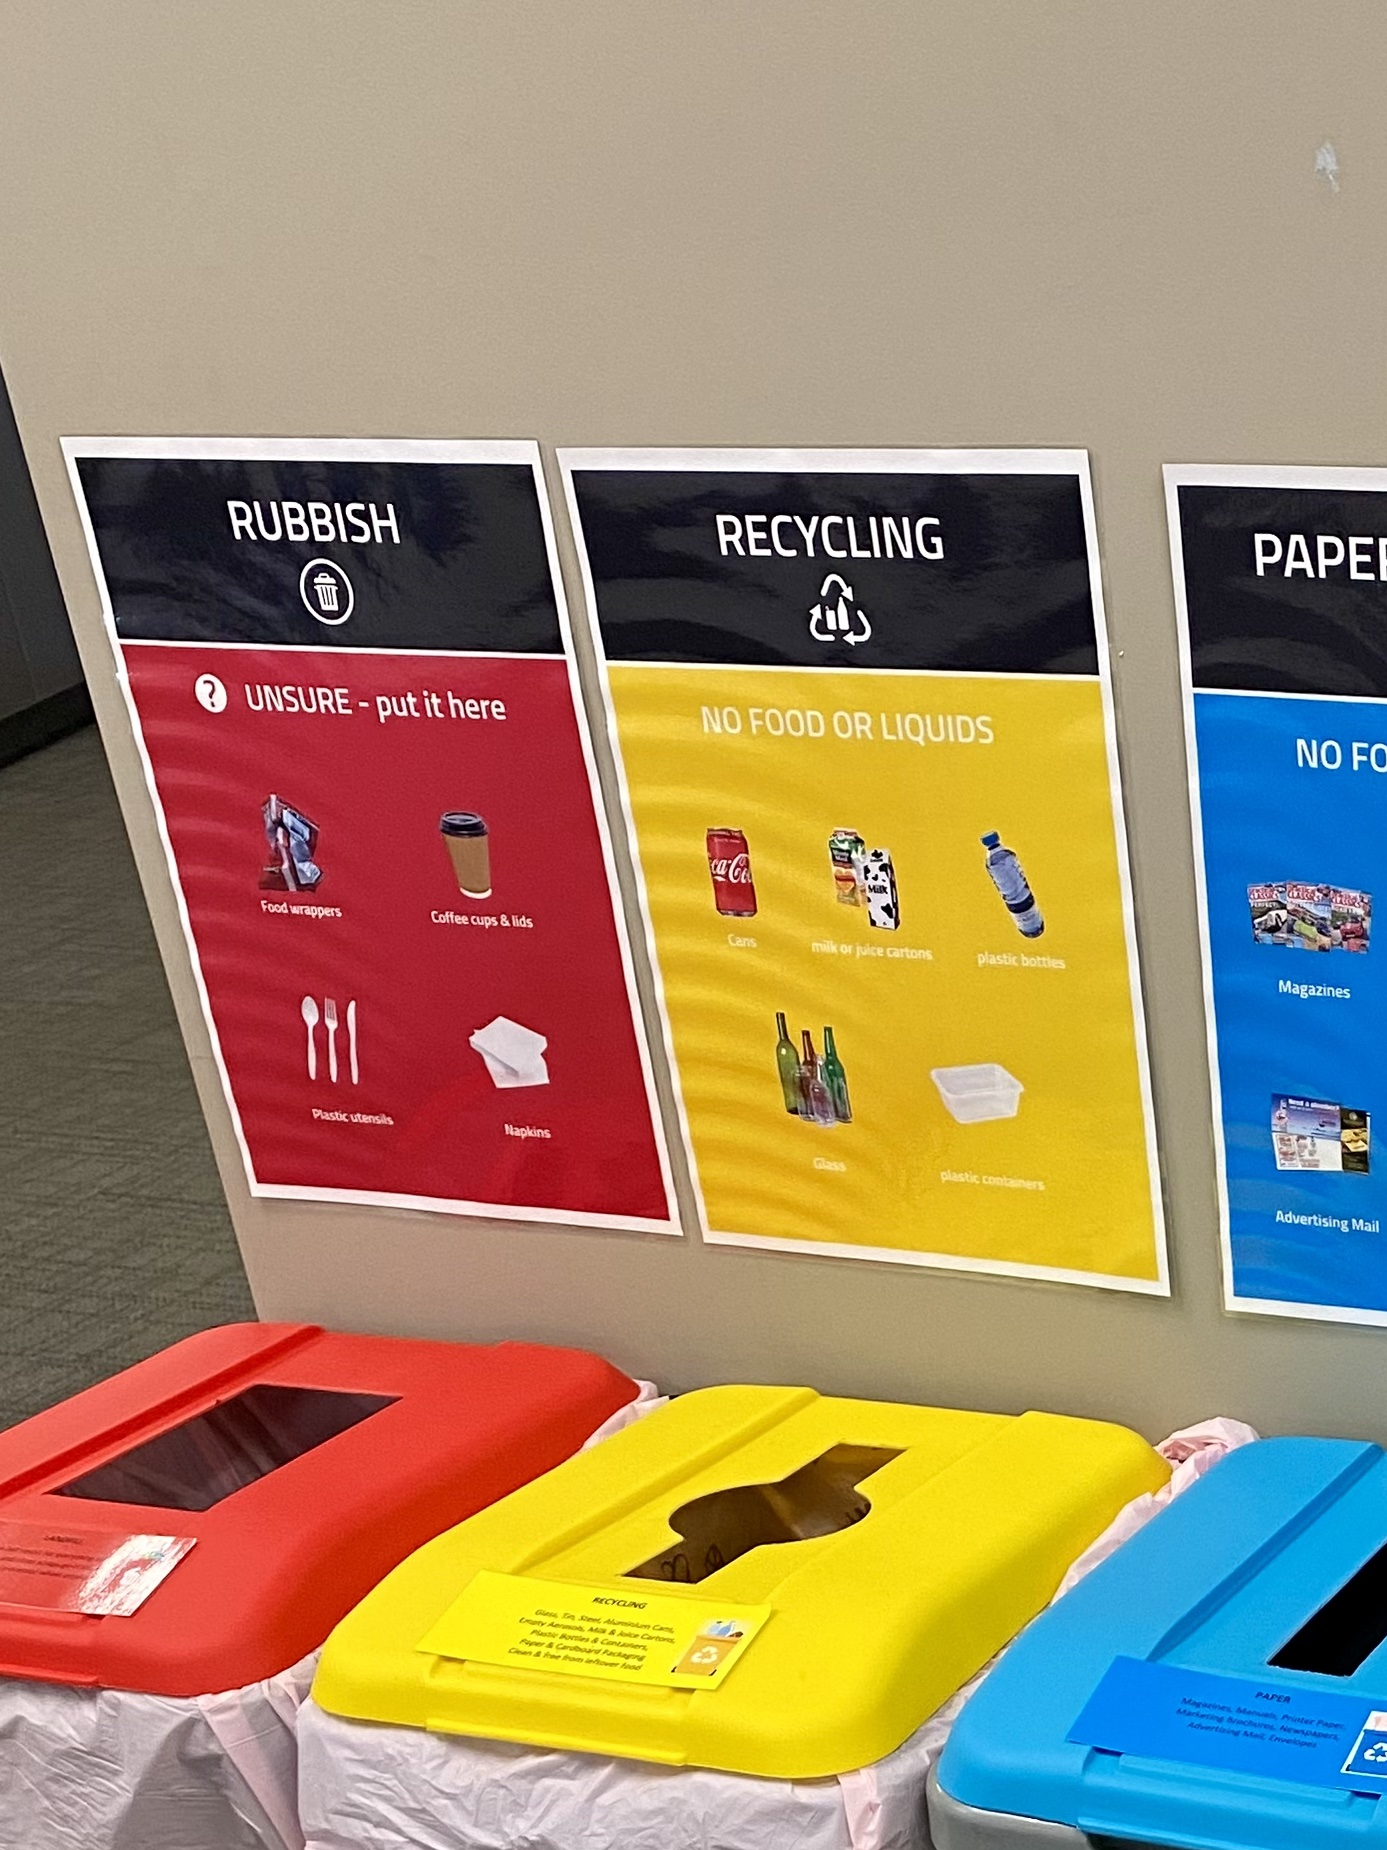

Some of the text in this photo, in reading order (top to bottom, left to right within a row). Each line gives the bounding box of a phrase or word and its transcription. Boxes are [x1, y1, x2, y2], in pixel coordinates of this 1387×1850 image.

[227, 500, 400, 544] RUBBISH
[716, 515, 944, 560] RECYCLING
[245, 684, 353, 714] UNSURE
[376, 692, 420, 723] put
[423, 690, 444, 718] it
[447, 691, 506, 720] here
[701, 706, 994, 746] NO FOOD OR LIQUIDS
[1297, 738, 1342, 769] NO
[260, 900, 342, 919] Food wrappers
[431, 910, 533, 929] Coffee cups & lids
[727, 934, 757, 948] Cans
[811, 940, 933, 960] milk or juice cartons
[977, 951, 1066, 969] plastic bottles
[1279, 980, 1351, 999] Magazines
[312, 1108, 394, 1125] Plastic utensils
[504, 1124, 551, 1139] Napkins
[813, 1157, 847, 1172] Glass
[940, 1169, 1045, 1191] plastic containers
[1276, 1210, 1379, 1233] Advertising Mail
[592, 1597, 647, 1609] RECYCLING
[1255, 1691, 1291, 1704] PAPER
